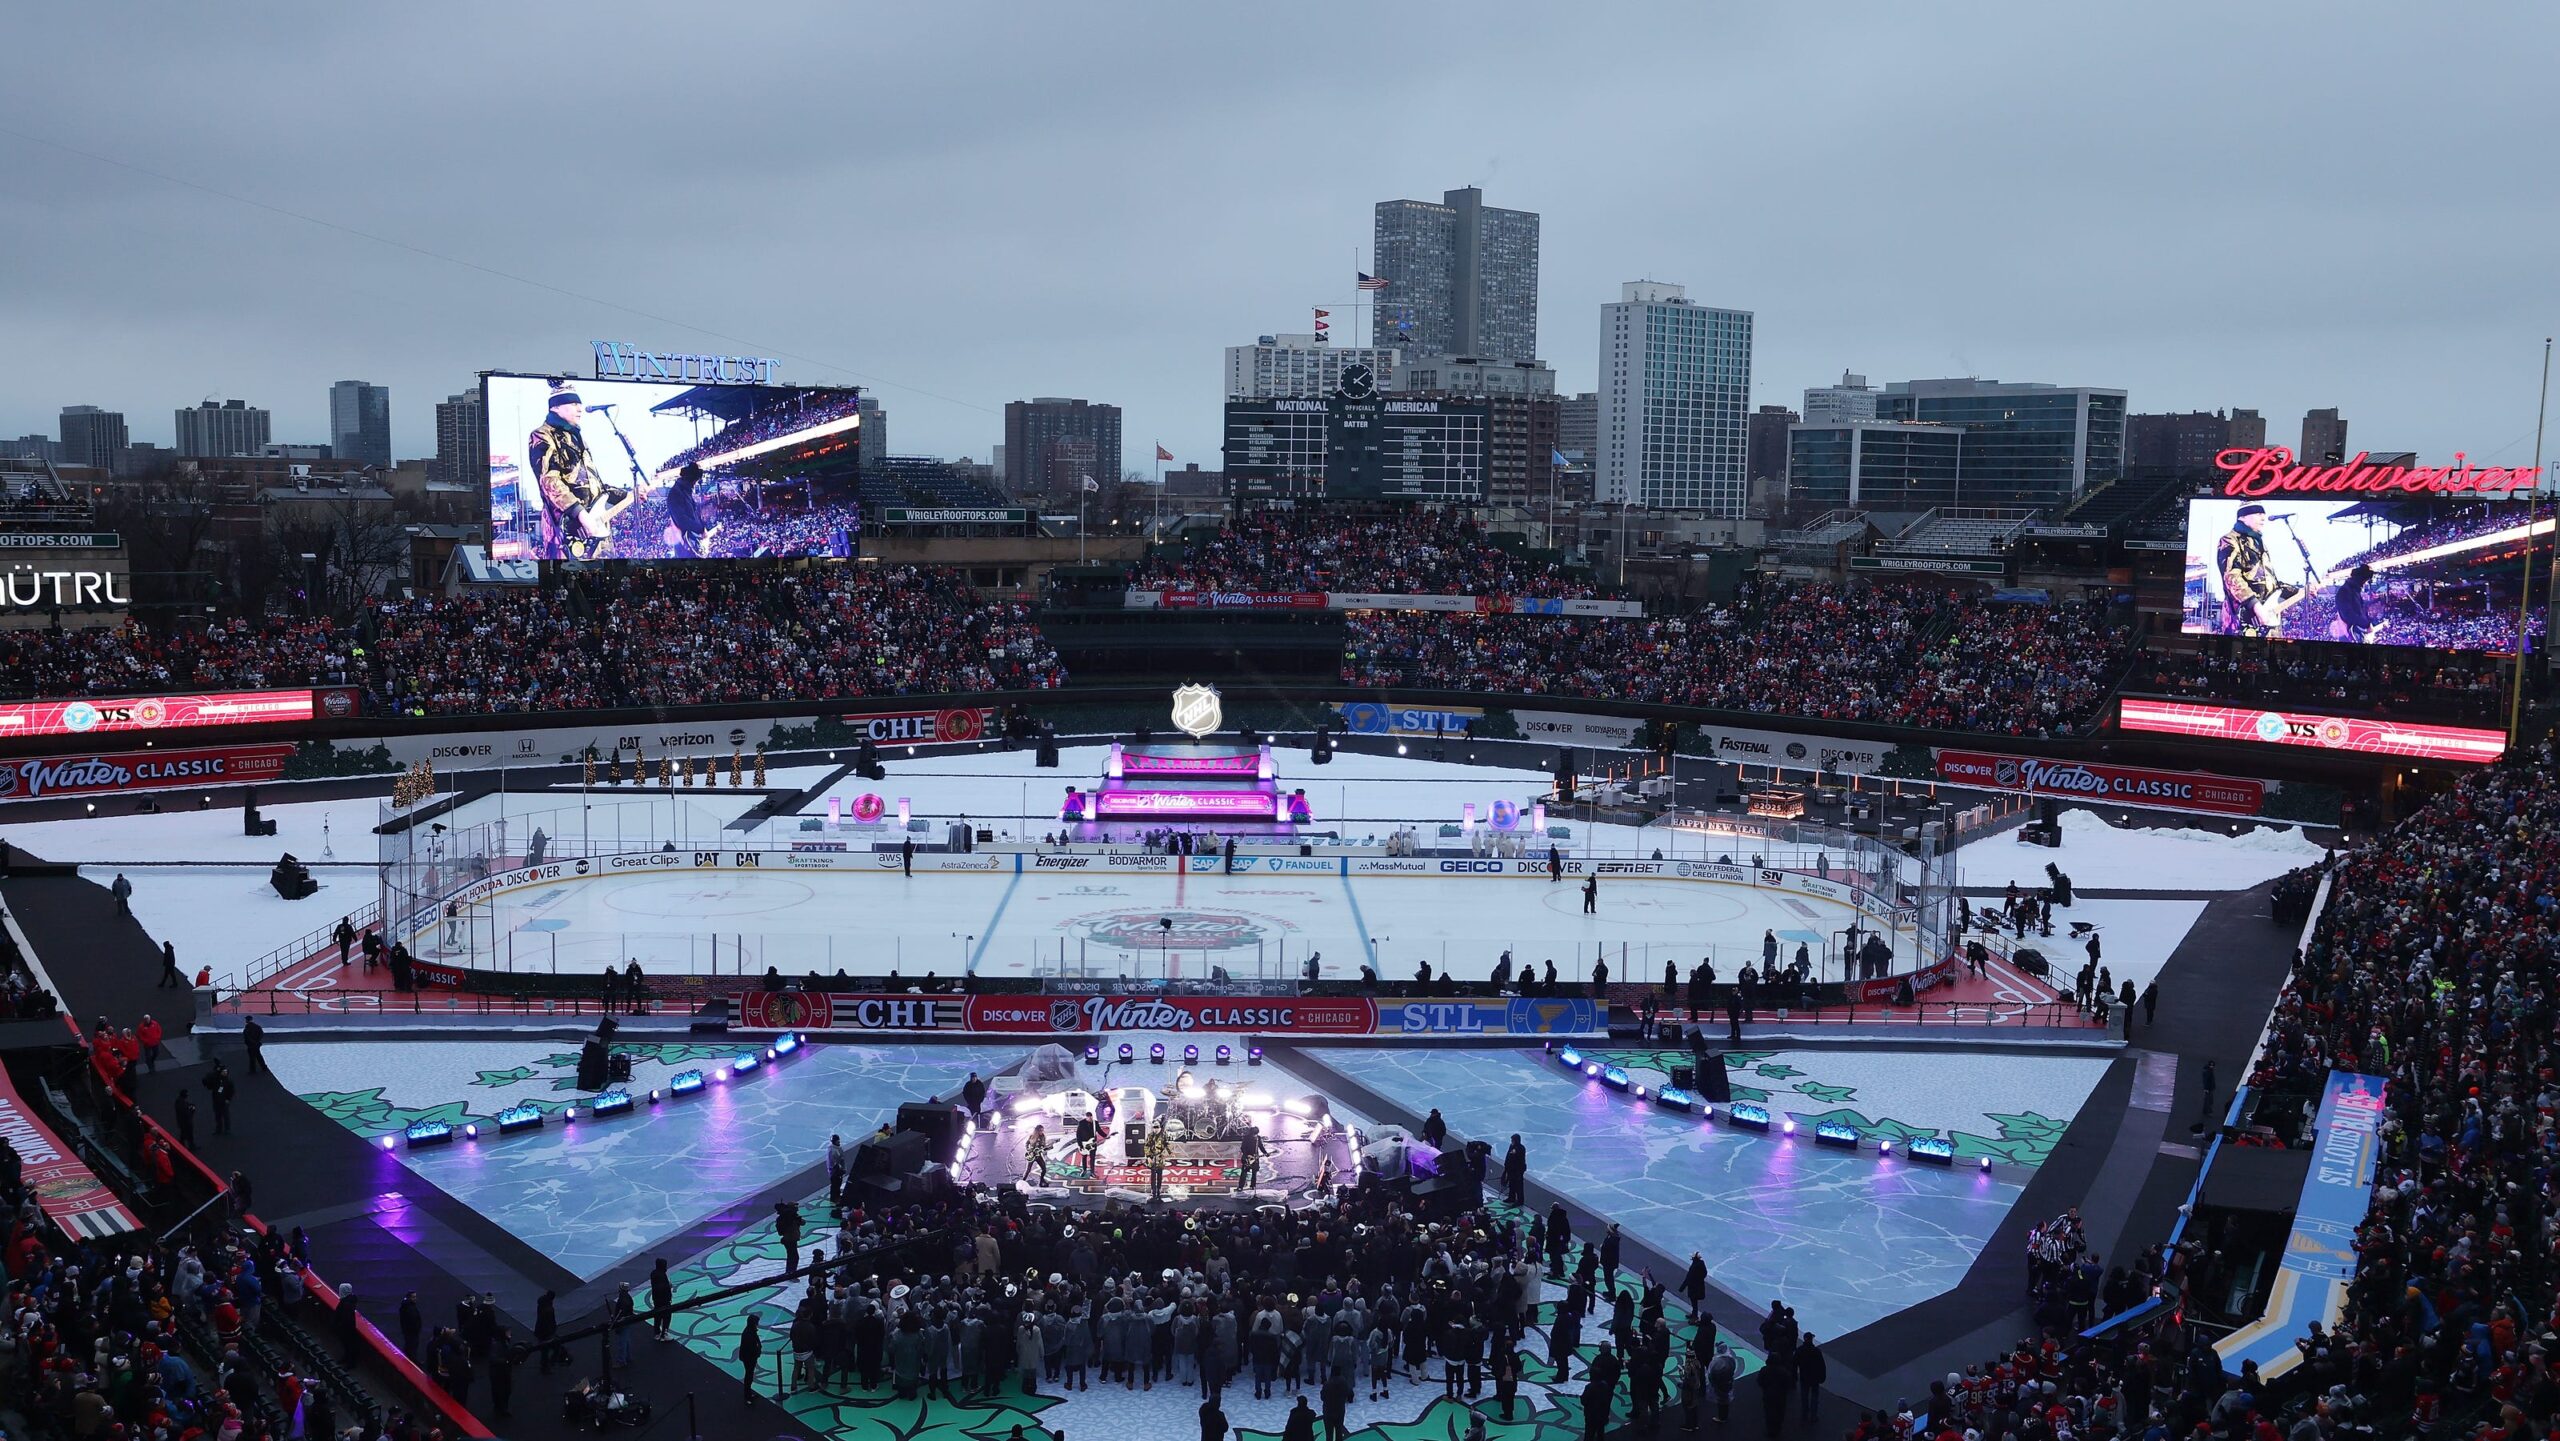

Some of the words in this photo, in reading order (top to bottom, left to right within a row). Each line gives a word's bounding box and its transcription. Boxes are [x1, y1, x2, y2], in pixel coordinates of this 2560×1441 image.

[590, 341, 781, 385] WINTRUST
[1275, 401, 1329, 411] NATIONAL
[1384, 402, 1438, 412] AMERICAN
[2214, 447, 2543, 496] Budweiser
[906, 510, 1008, 520] WRIGLEYROOFTOPS.COM
[1880, 559, 1971, 571] WRIGLEYROOFTOPS.COM
[0, 564, 128, 606] ÜTRL
[1210, 592, 1254, 605] Winter
[1255, 595, 1293, 603] CLASSIC
[1183, 697, 1212, 724] NHL
[867, 716, 926, 741] CHI
[1402, 710, 1460, 732] STL
[1526, 721, 1573, 733] DISCOVER
[1585, 724, 1627, 736] BODYARMOR
[619, 736, 642, 750] CAT
[659, 732, 715, 748] verizon
[1719, 736, 1771, 754] FASTENAL
[432, 745, 493, 758] DISCOVER
[1821, 748, 1873, 764] DISCOVER
[21, 760, 132, 797] Winter
[136, 758, 225, 779] CLASSIC
[238, 758, 278, 770] CHICAGO
[1944, 762, 1992, 776] DISCOVER
[2020, 759, 2108, 794] Winter
[2113, 777, 2192, 799] CLASSIC
[2205, 789, 2245, 802] CHICAGO
[1151, 793, 1196, 808] Winter
[1197, 797, 1236, 806] CLASSIC
[1708, 822, 1733, 831] NEW
[611, 856, 650, 868] Great
[651, 855, 681, 866] Clips
[694, 852, 719, 867] CAT
[736, 852, 761, 867] CAT
[788, 855, 834, 864] DRAFTKINGS
[878, 853, 902, 862] aws
[1036, 855, 1090, 869] Energizer
[1109, 856, 1167, 866] BODYARMOR
[1193, 859, 1213, 869] SAP
[1231, 859, 1252, 869] SAP
[1285, 860, 1333, 869] FANDUEL
[941, 861, 989, 870] AstraZeneca
[1370, 861, 1425, 870] MassMutual
[1440, 861, 1503, 872] GEICO
[1713, 865, 1744, 873] FEDERAL
[507, 865, 561, 887] DISCOVER
[1692, 871, 1719, 879] CREDIT
[1761, 870, 1783, 881] SN
[469, 878, 504, 899] HONDA
[1879, 903, 1917, 924] DISCOVE
[1077, 917, 1268, 934] Winter
[420, 969, 457, 986] ASSIC
[857, 1001, 939, 1028] CHI
[983, 1009, 1045, 1022] DISCOVER
[1053, 1007, 1076, 1026] NHL
[1083, 996, 1194, 1032] Winter
[1199, 1008, 1293, 1026] CLASSIC
[1307, 1012, 1352, 1023] CHICAGO
[1402, 1003, 1483, 1032] STL
[2331, 1092, 2379, 1132] BLUES
[2323, 1129, 2361, 1166] LOUIS
[2318, 1166, 2354, 1187] ST.
